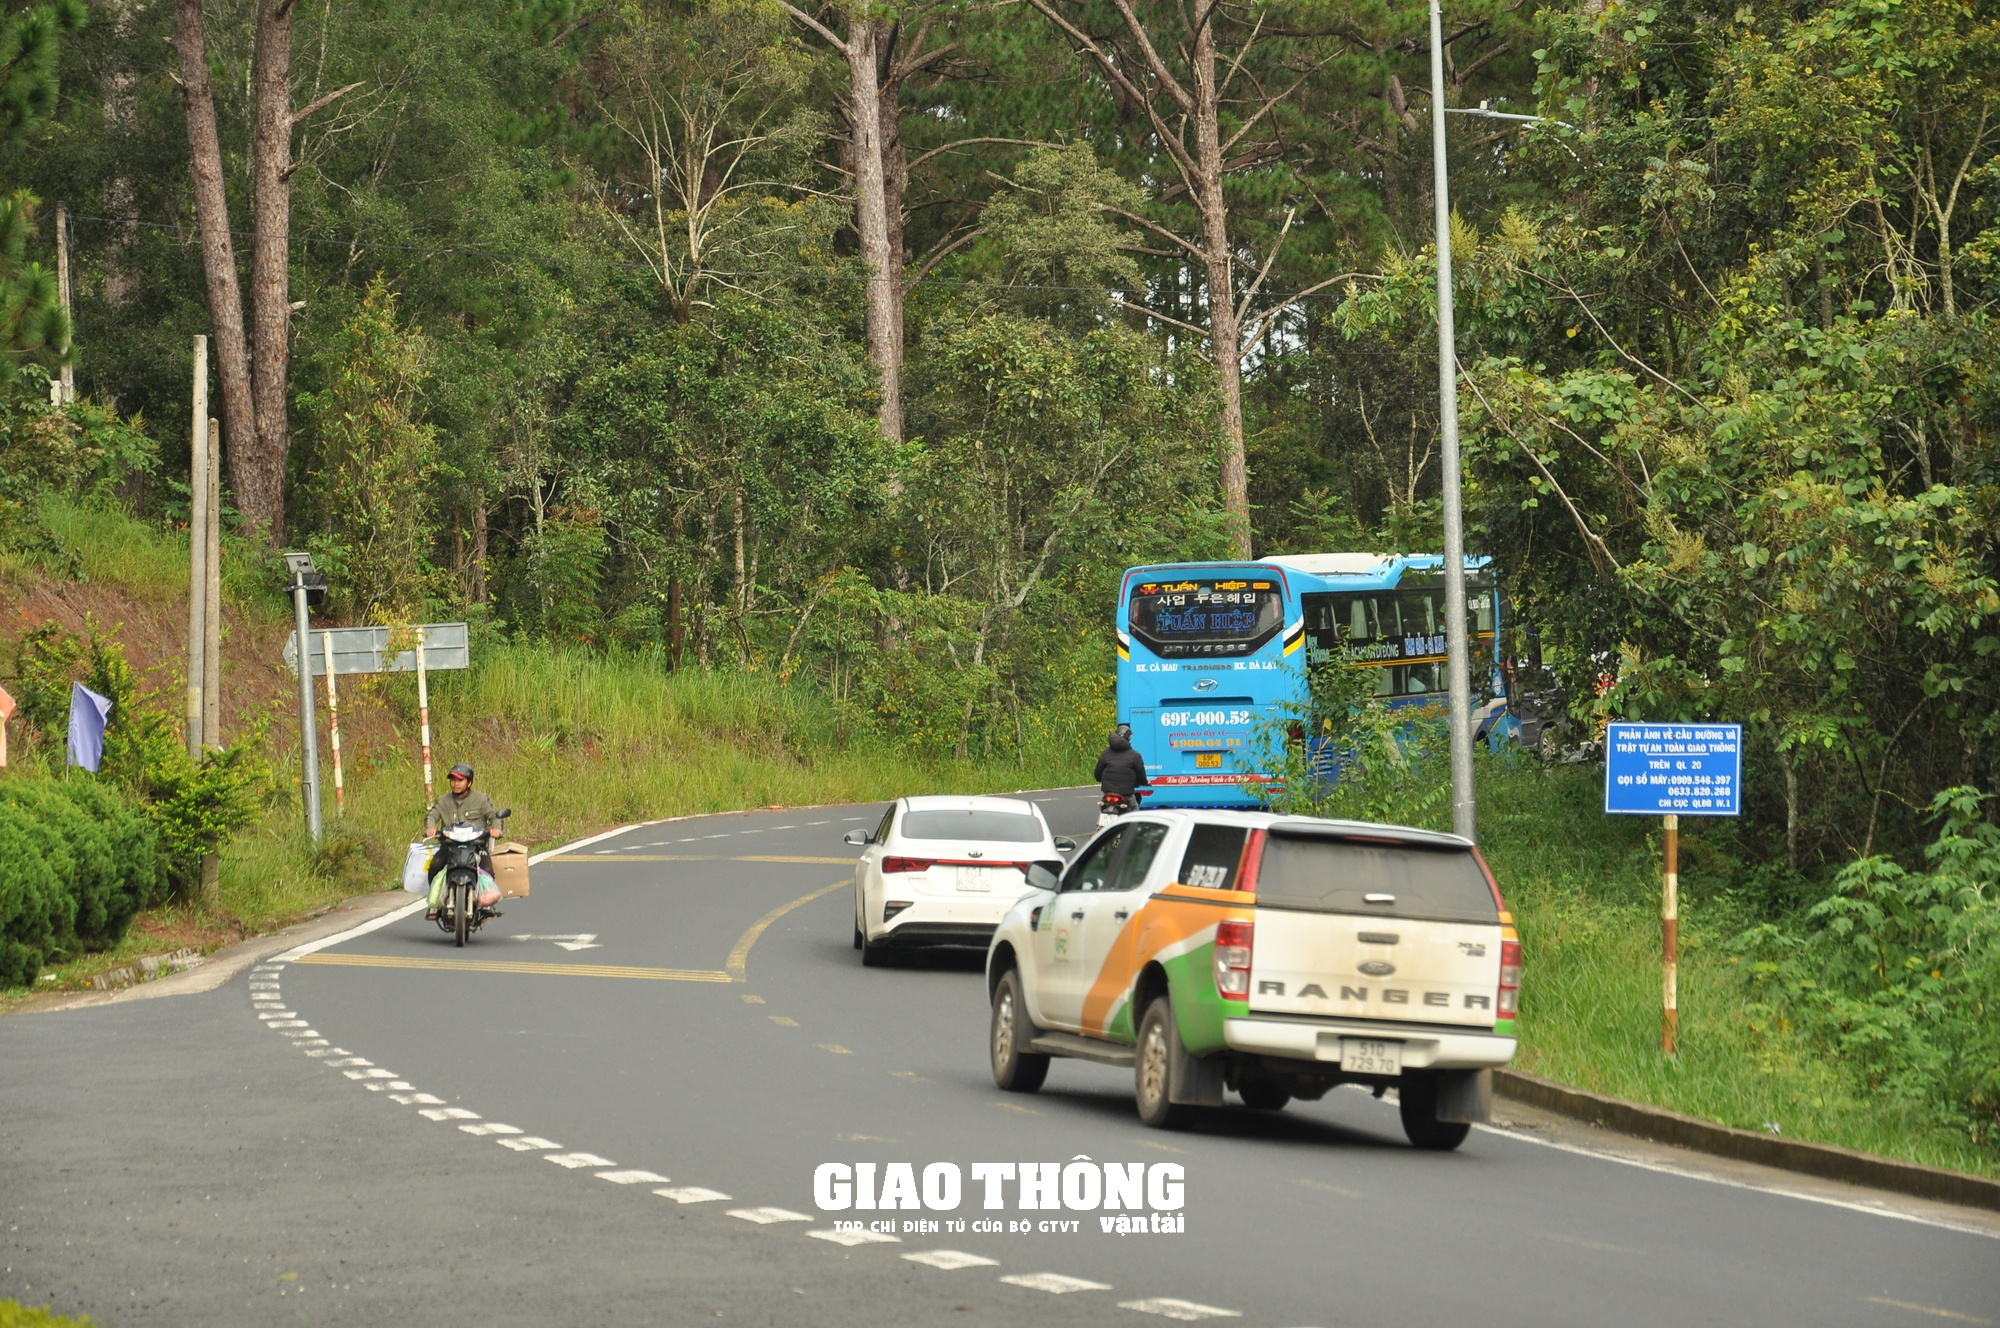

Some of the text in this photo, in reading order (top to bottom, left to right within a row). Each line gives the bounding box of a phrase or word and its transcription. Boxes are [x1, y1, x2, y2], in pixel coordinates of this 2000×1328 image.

[1162, 581, 1198, 592] TUẤN
[1215, 581, 1247, 590] HIỆP
[1160, 608, 1255, 631] TUẤN HIỆP
[1164, 644, 1248, 653] UNIVERSE
[1136, 662, 1178, 672] BX. CÀ MAU
[1234, 662, 1247, 670] BX.
[1249, 660, 1260, 670] ĐÀ
[1161, 710, 1250, 727] 69F-000.53
[1619, 728, 1641, 740] PHẢN
[1663, 726, 1673, 740] VỀ
[1675, 727, 1692, 740] CẦU
[1726, 728, 1736, 740] VÀ
[1616, 742, 1736, 754] TRẬT TỰ AN TOÀN GIAO THÔNG
[1649, 759, 1702, 770] TRÊN QL 20
[1618, 776, 1633, 786] GỌI
[1636, 771, 1647, 785] SỐ
[1668, 787, 1731, 796] 0633.820.268
[1659, 799, 1672, 807] CHI
[1673, 799, 1688, 808] CỤC
[1716, 799, 1731, 807] IV.1
[966, 867, 983, 878] 60A
[1259, 980, 1491, 1010] RANGER
[1350, 1056, 1394, 1073] 729.70
